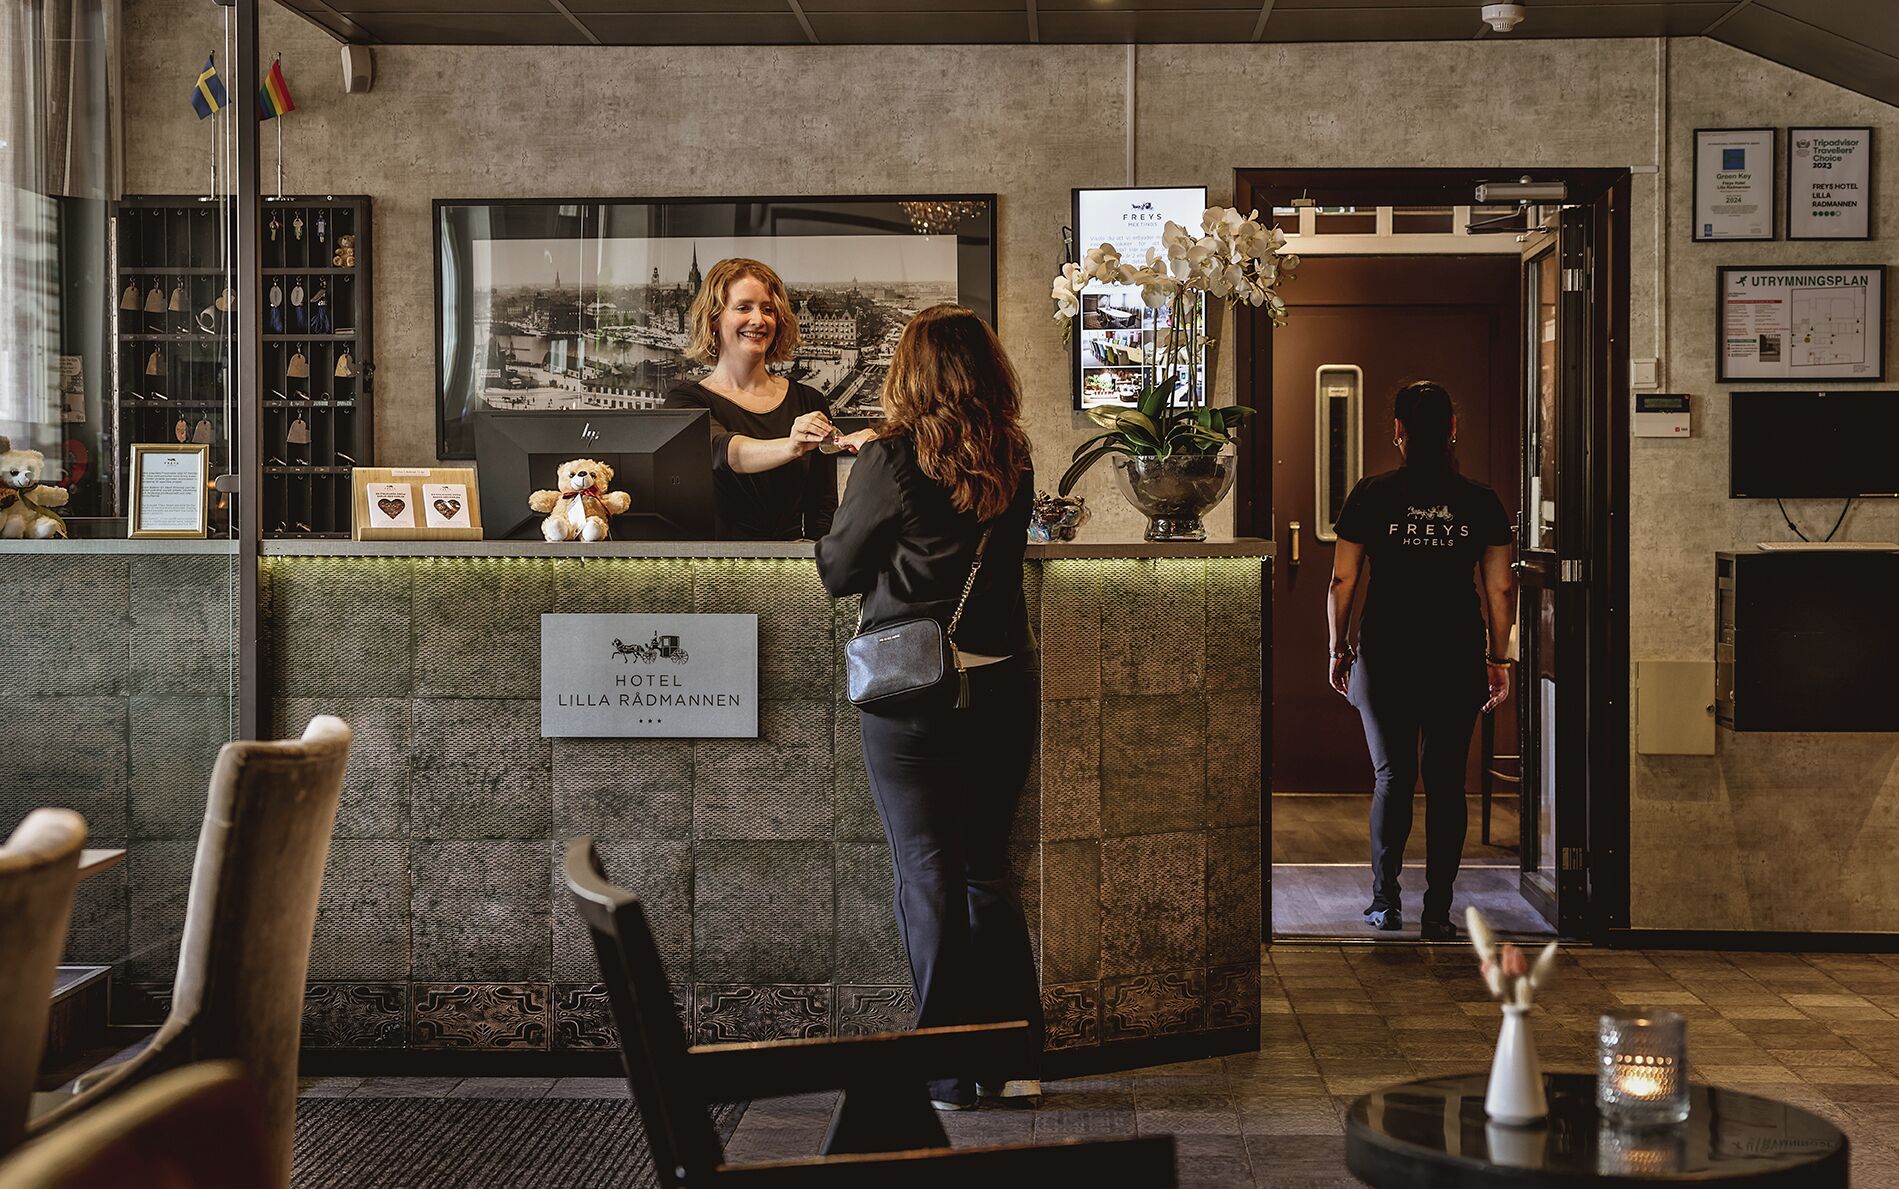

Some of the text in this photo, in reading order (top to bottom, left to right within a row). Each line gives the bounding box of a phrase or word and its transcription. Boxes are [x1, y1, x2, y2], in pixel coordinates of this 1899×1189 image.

[1813, 139, 1859, 147] Tripadvisor
[1122, 213, 1162, 221] FREYS
[1751, 275, 1869, 287] UTRYMNINGSPLAN
[1389, 523, 1469, 537] FREYS
[1402, 538, 1454, 547] HOTELS
[615, 674, 683, 687] HOTEL
[558, 691, 741, 707] LILLA RÅDMANNEN
